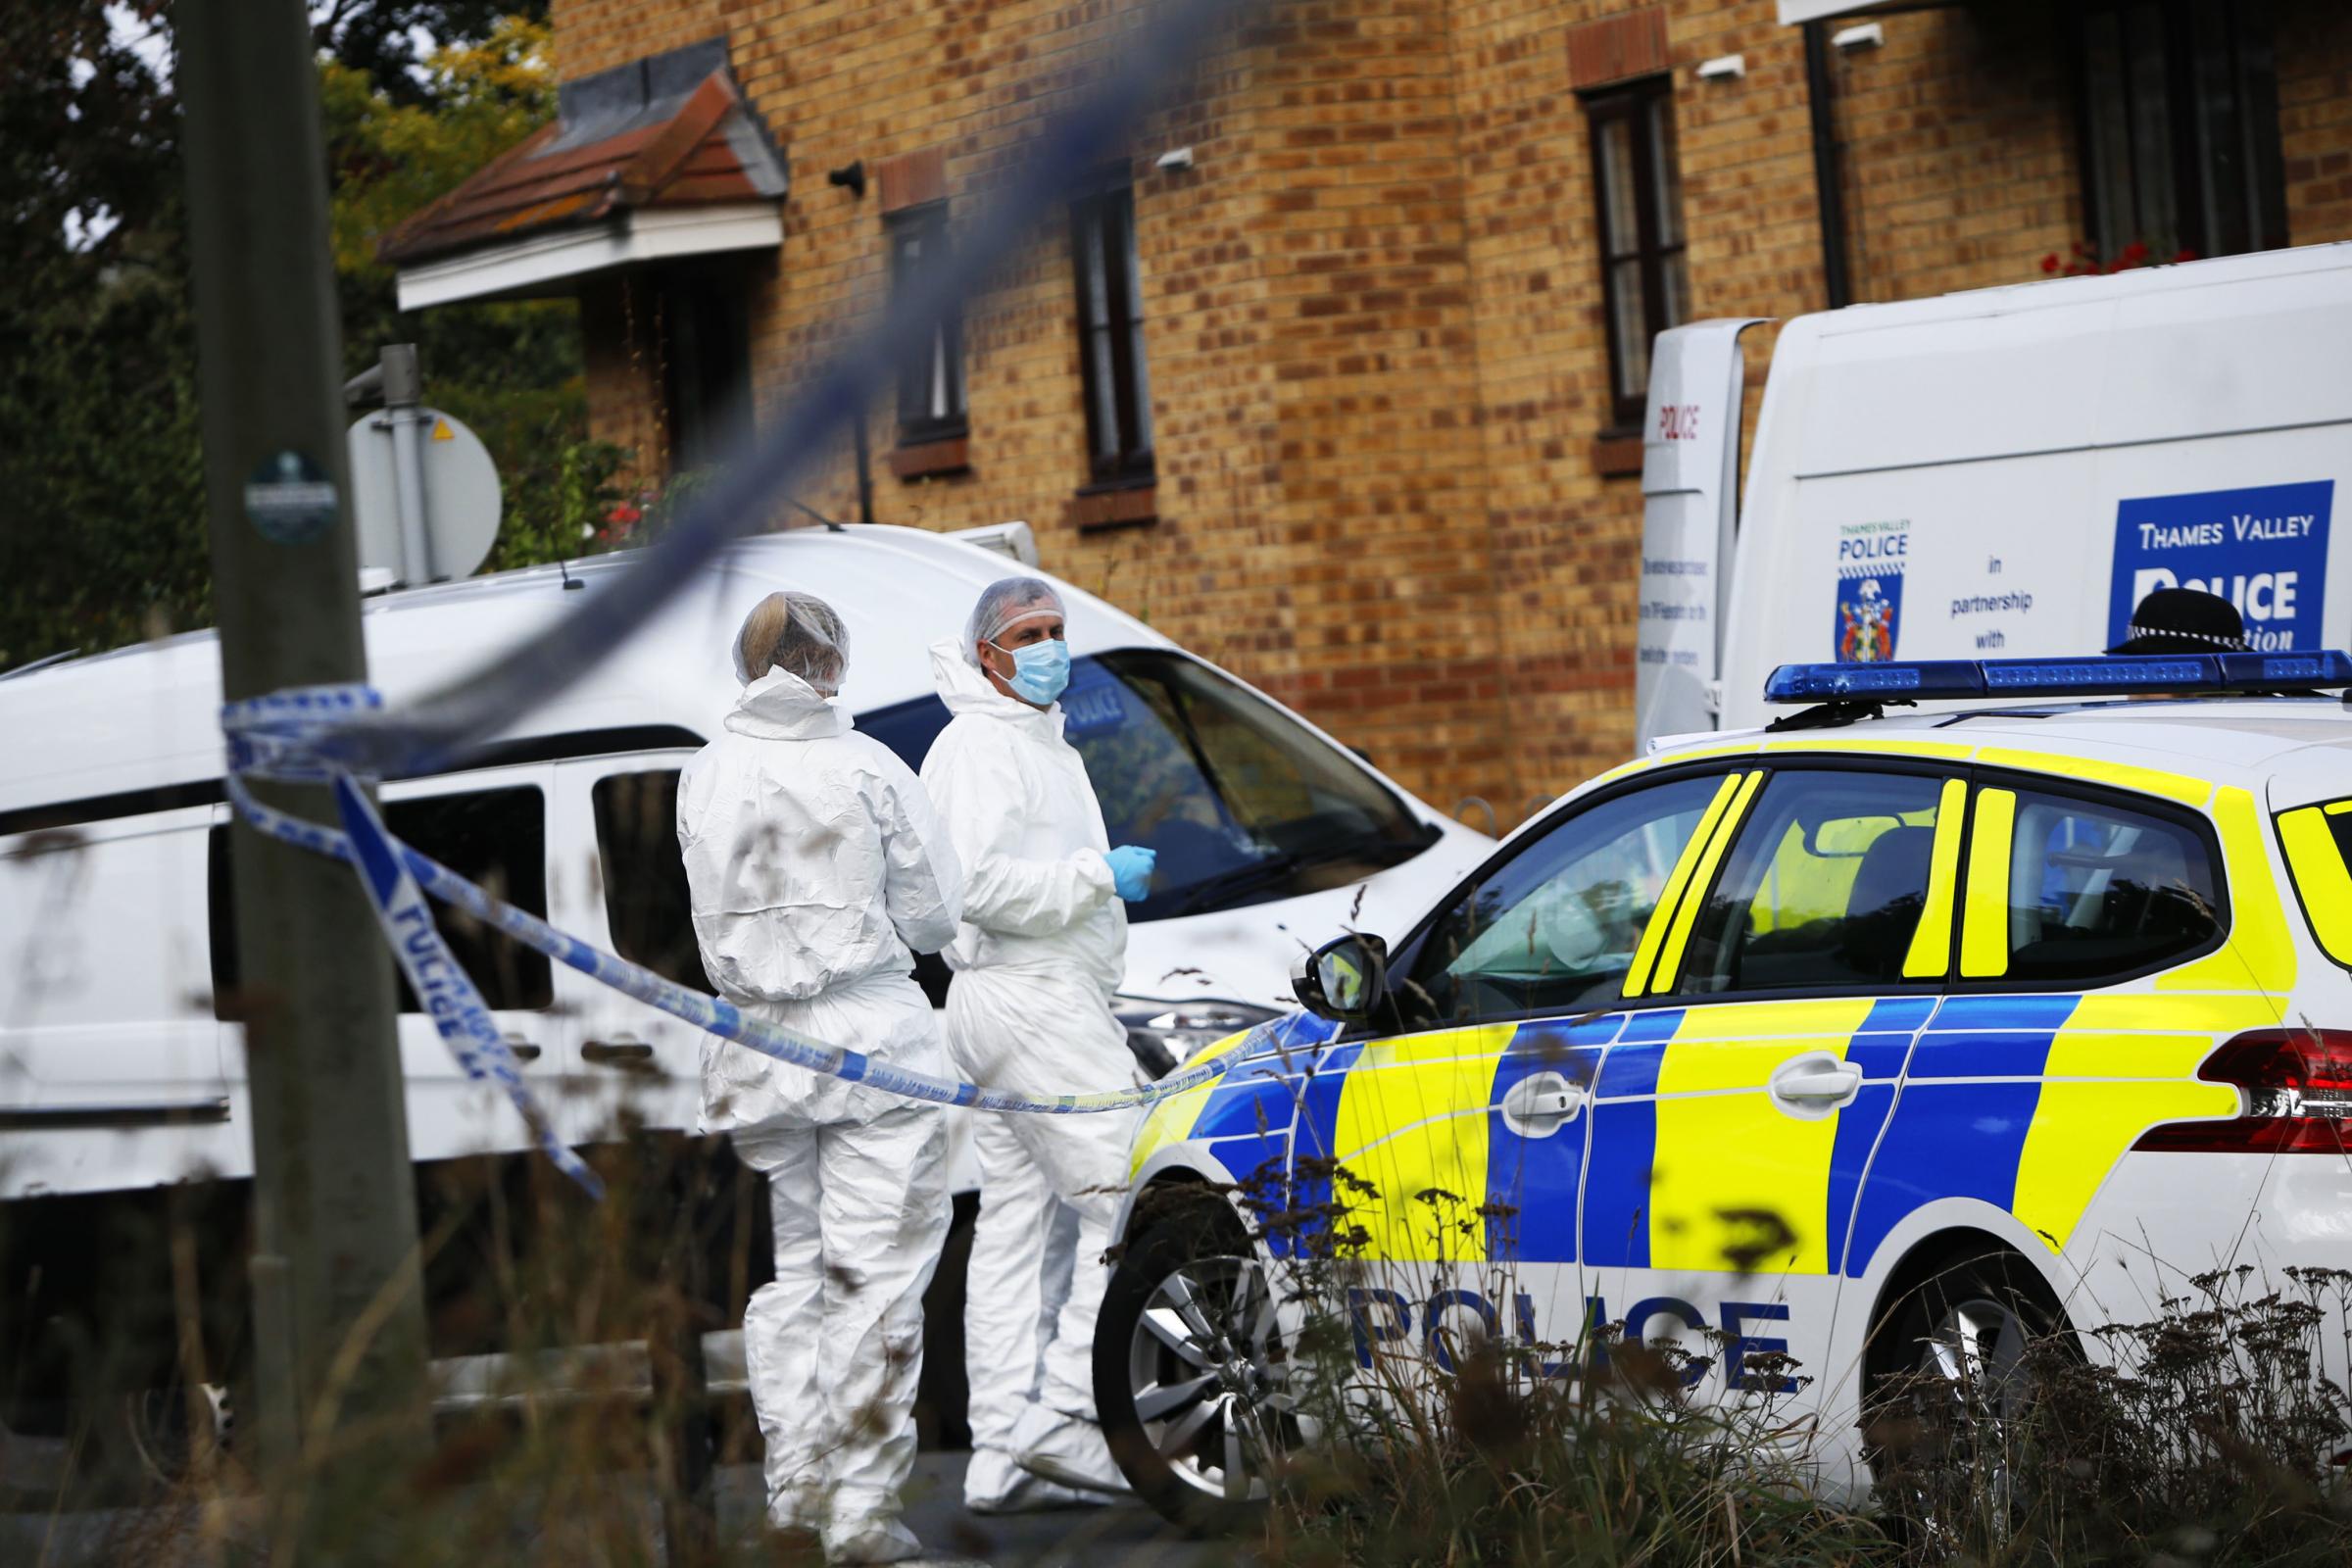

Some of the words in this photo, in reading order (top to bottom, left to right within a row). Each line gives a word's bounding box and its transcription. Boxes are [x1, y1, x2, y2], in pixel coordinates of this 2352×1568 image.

[1660, 405, 1701, 440] POLICE
[2138, 522, 2225, 551] THAMES
[2232, 514, 2315, 541] VALLEY
[1838, 533, 1908, 561] POLICE
[1988, 555, 2002, 574] in
[1950, 590, 2033, 619] partnership
[1976, 628, 2006, 649] with
